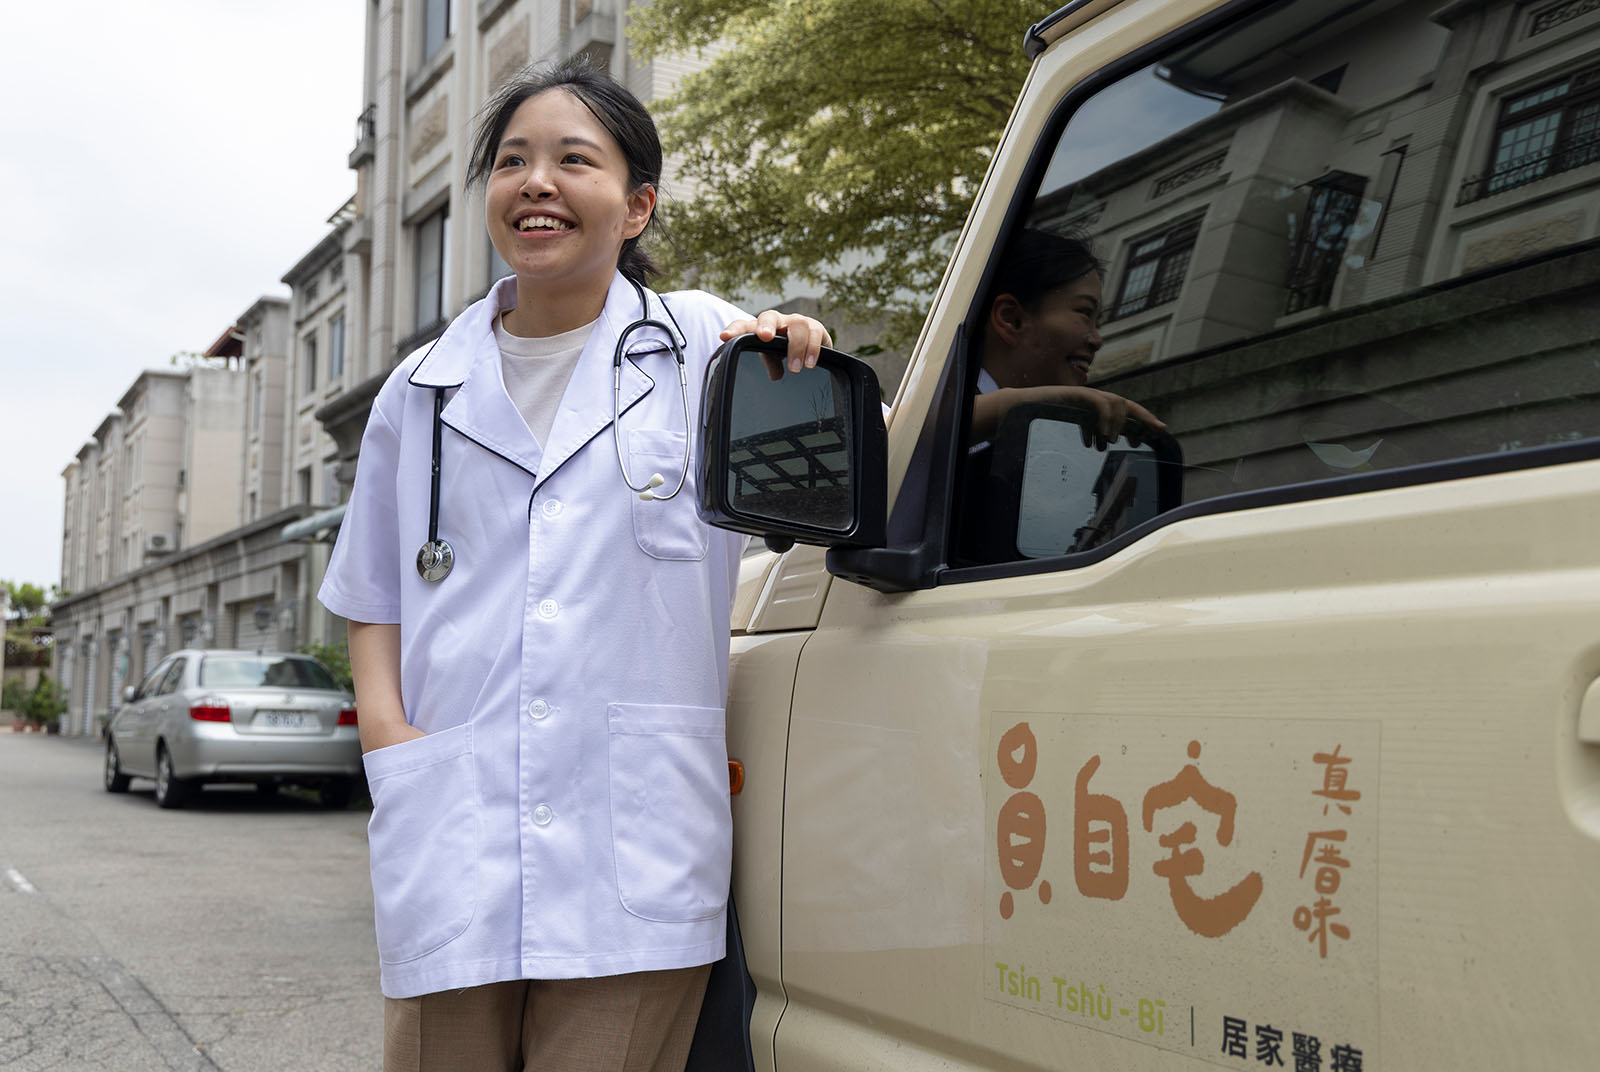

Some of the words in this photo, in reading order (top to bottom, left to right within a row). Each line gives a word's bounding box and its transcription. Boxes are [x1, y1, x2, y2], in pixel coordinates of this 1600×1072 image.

[1293, 745, 1361, 958] 真厝味
[995, 962, 1041, 1001] Tsin
